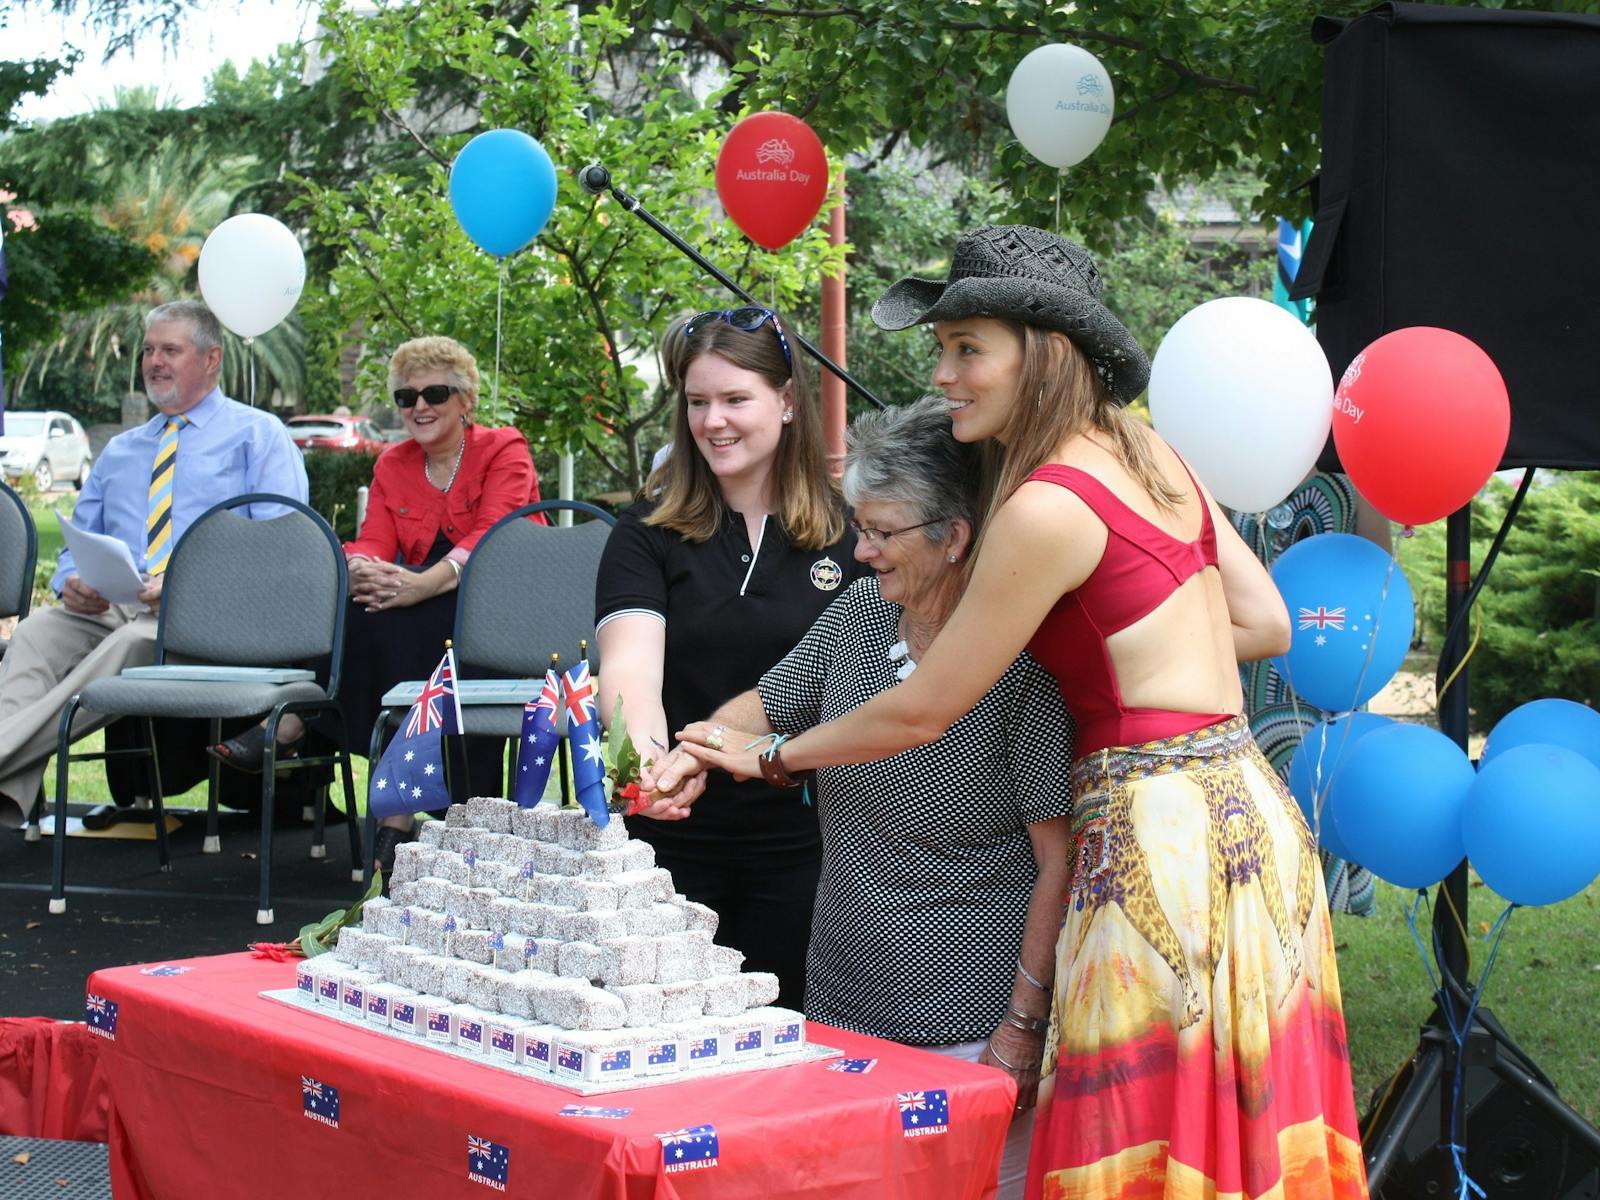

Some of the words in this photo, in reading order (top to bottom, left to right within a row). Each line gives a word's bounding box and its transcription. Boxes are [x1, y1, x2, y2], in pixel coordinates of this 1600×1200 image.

[736, 169, 787, 181] Australia
[790, 170, 810, 186] Day
[1342, 397, 1365, 424] Day
[87, 1025, 115, 1041] AUSTRALIA
[303, 1109, 340, 1129] AUSTRALIA
[904, 1125, 947, 1137] AUSTRALIA
[664, 1158, 718, 1173] AUSTRALIA
[467, 1171, 506, 1193] AUSTRALIA
